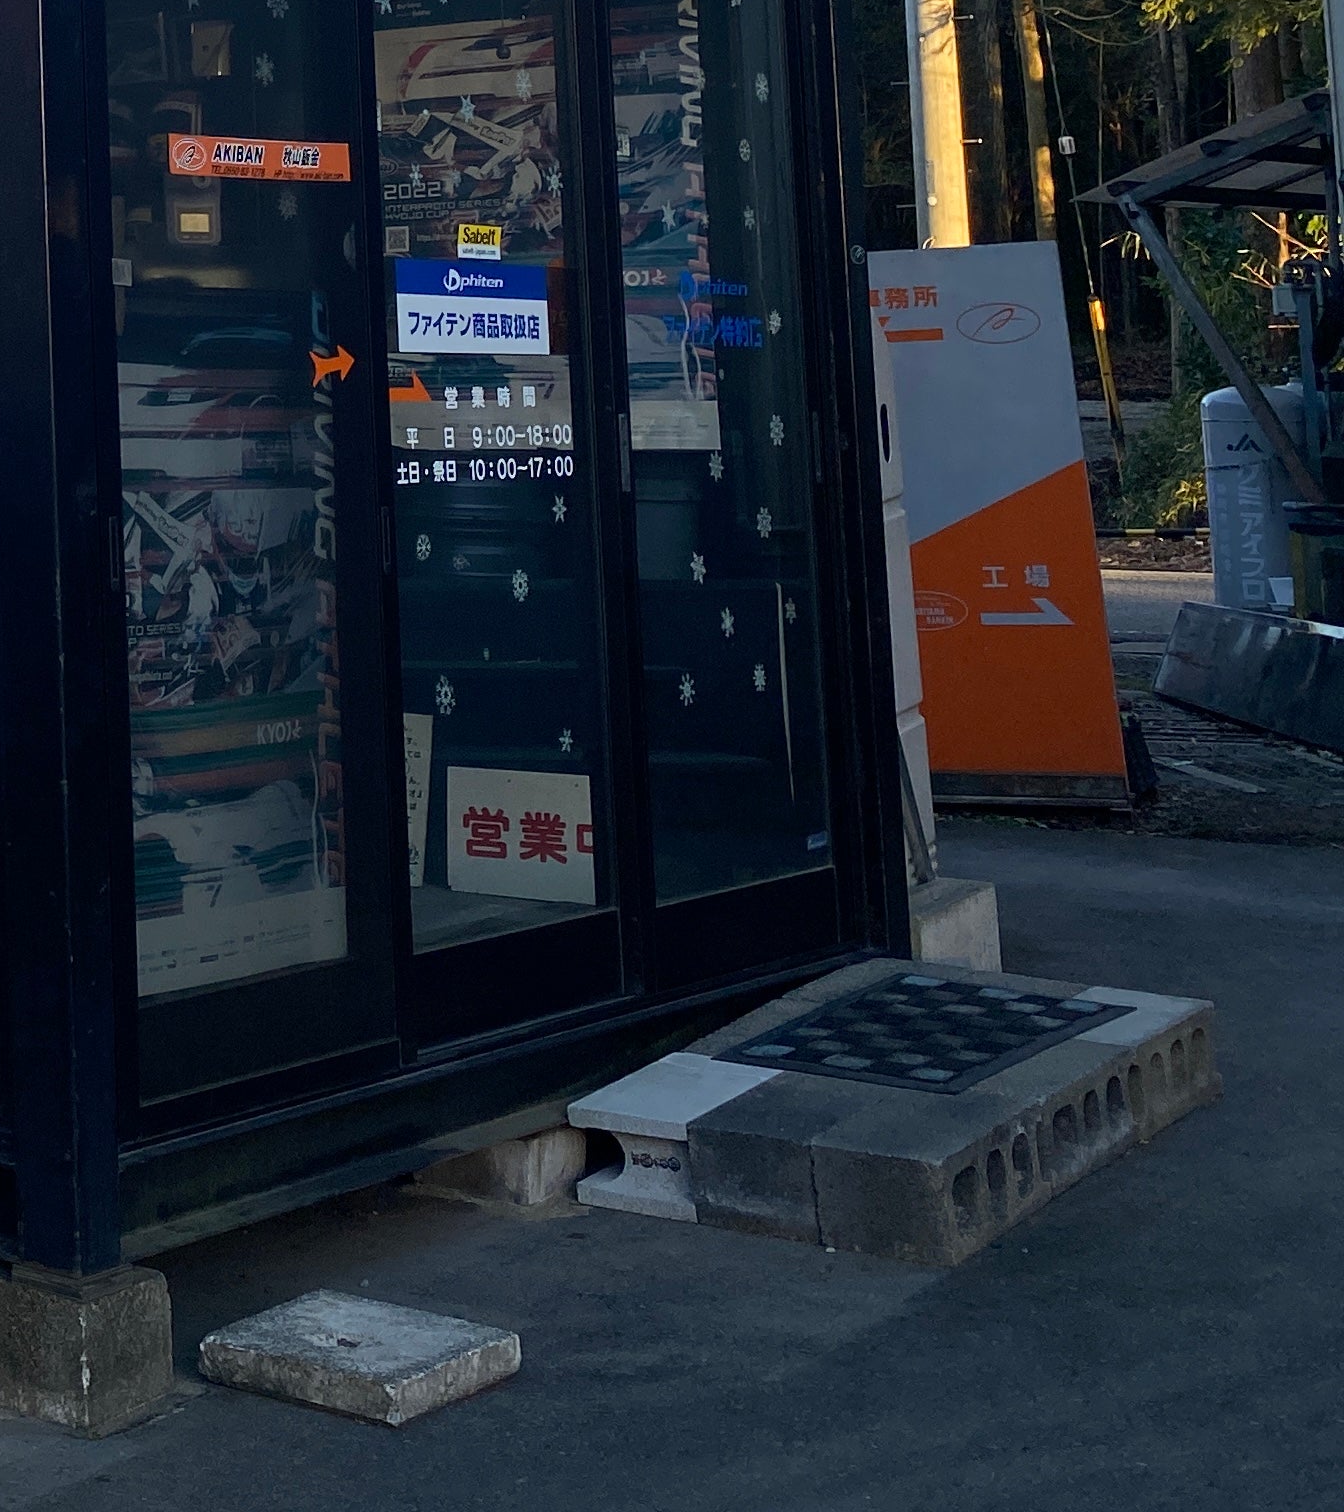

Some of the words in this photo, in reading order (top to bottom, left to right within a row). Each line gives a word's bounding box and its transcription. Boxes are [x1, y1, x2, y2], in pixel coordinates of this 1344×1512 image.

[212, 142, 265, 164] AKIBAN
[384, 181, 441, 200] 2022
[463, 227, 496, 246] Sabelt
[460, 273, 504, 291] phiten
[408, 311, 540, 340] ファイテン商品取扱店
[444, 386, 536, 409] 営業時間
[406, 427, 455, 449] 平日
